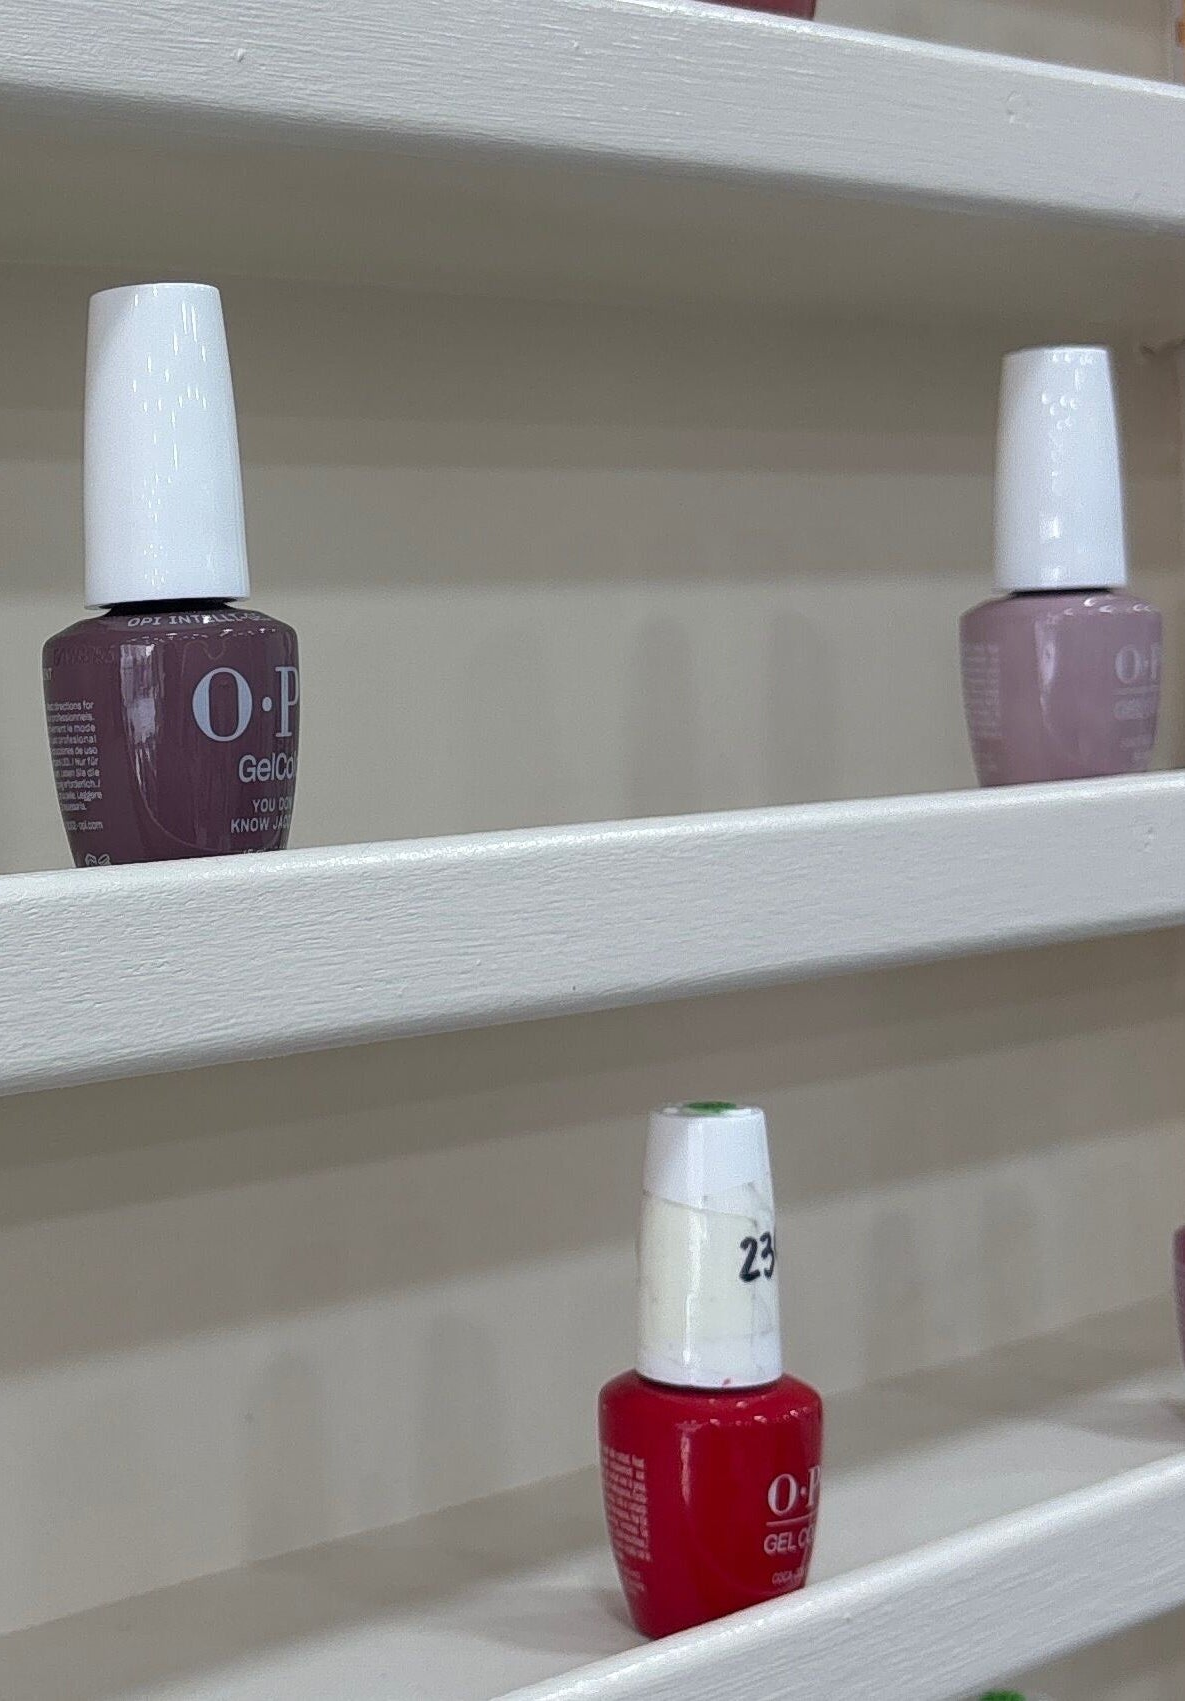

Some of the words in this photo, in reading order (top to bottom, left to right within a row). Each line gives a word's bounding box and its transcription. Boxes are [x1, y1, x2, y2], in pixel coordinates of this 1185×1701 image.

[127, 615, 161, 627] OPI
[238, 752, 296, 783] GelCo
[252, 797, 276, 813] YOU
[230, 817, 270, 834] KNOW
[739, 1231, 775, 1282] 23
[763, 1531, 797, 1557] GEL
